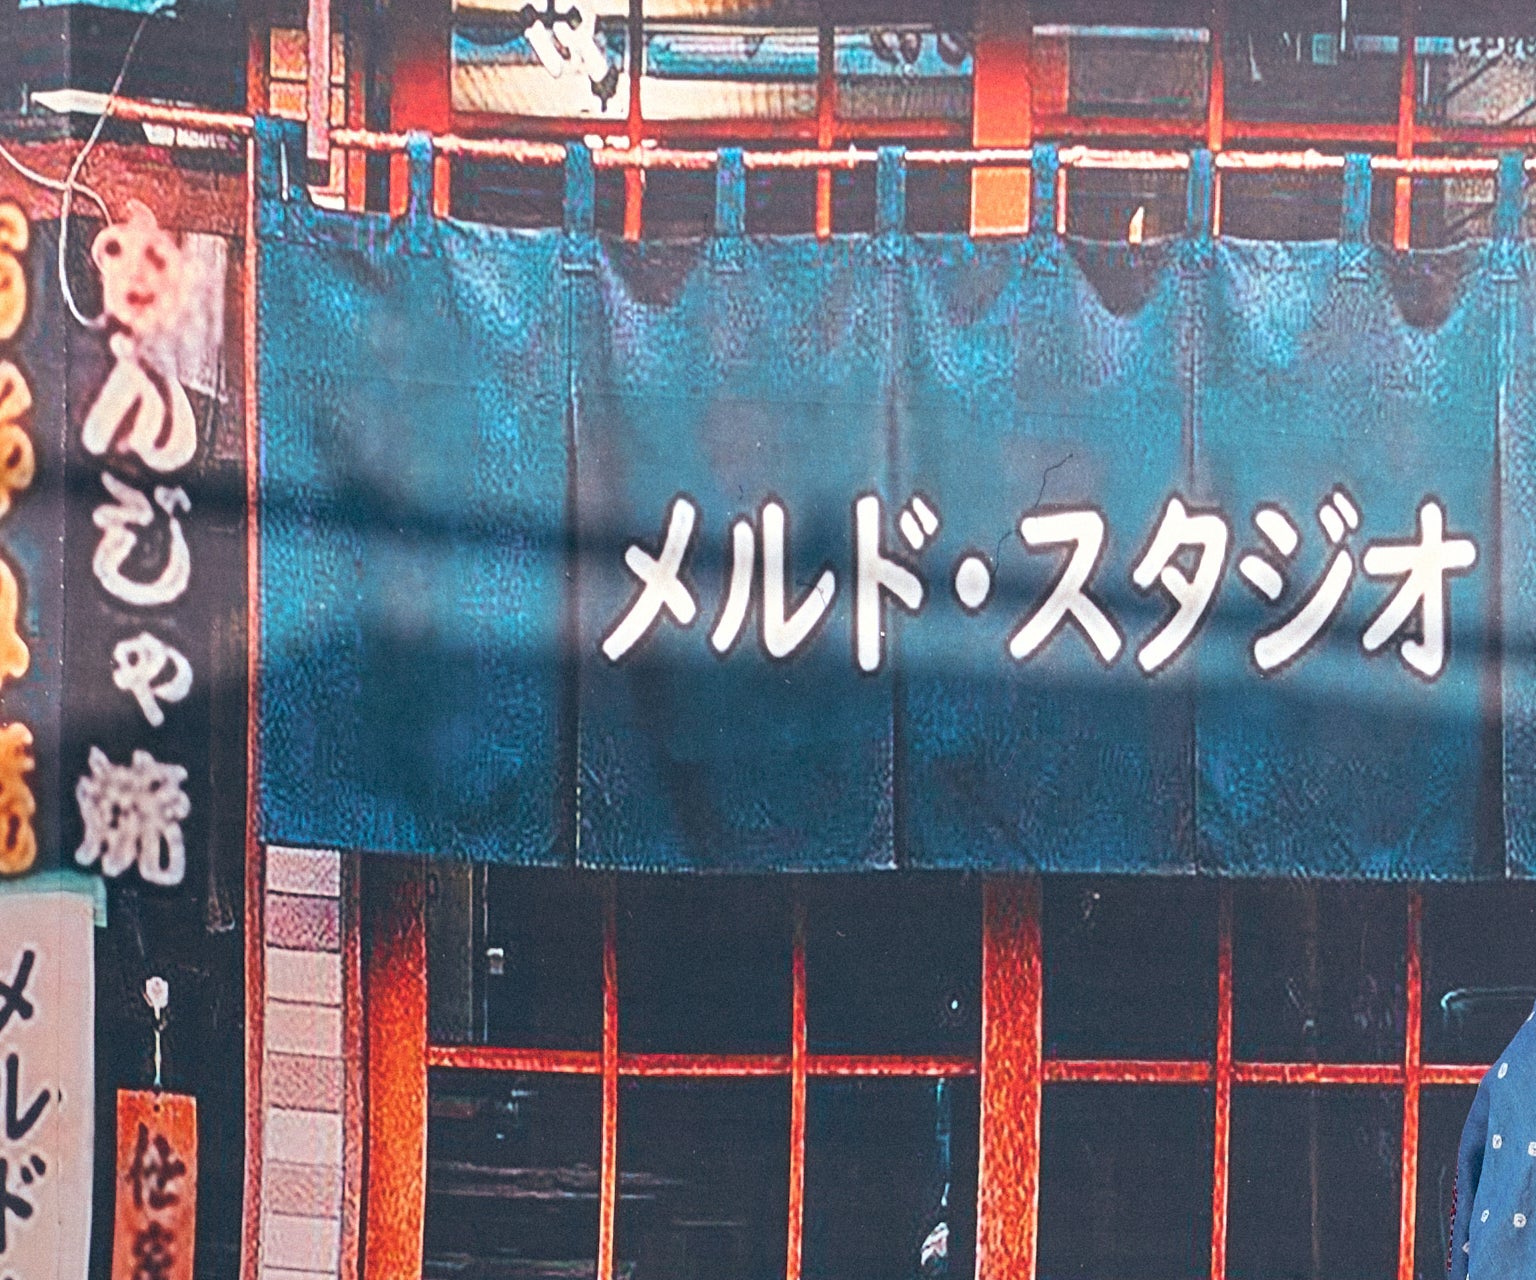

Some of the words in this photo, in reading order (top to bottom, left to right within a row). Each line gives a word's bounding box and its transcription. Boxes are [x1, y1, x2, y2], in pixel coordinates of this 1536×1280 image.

[602, 490, 1476, 678] メルド・スタジオ
